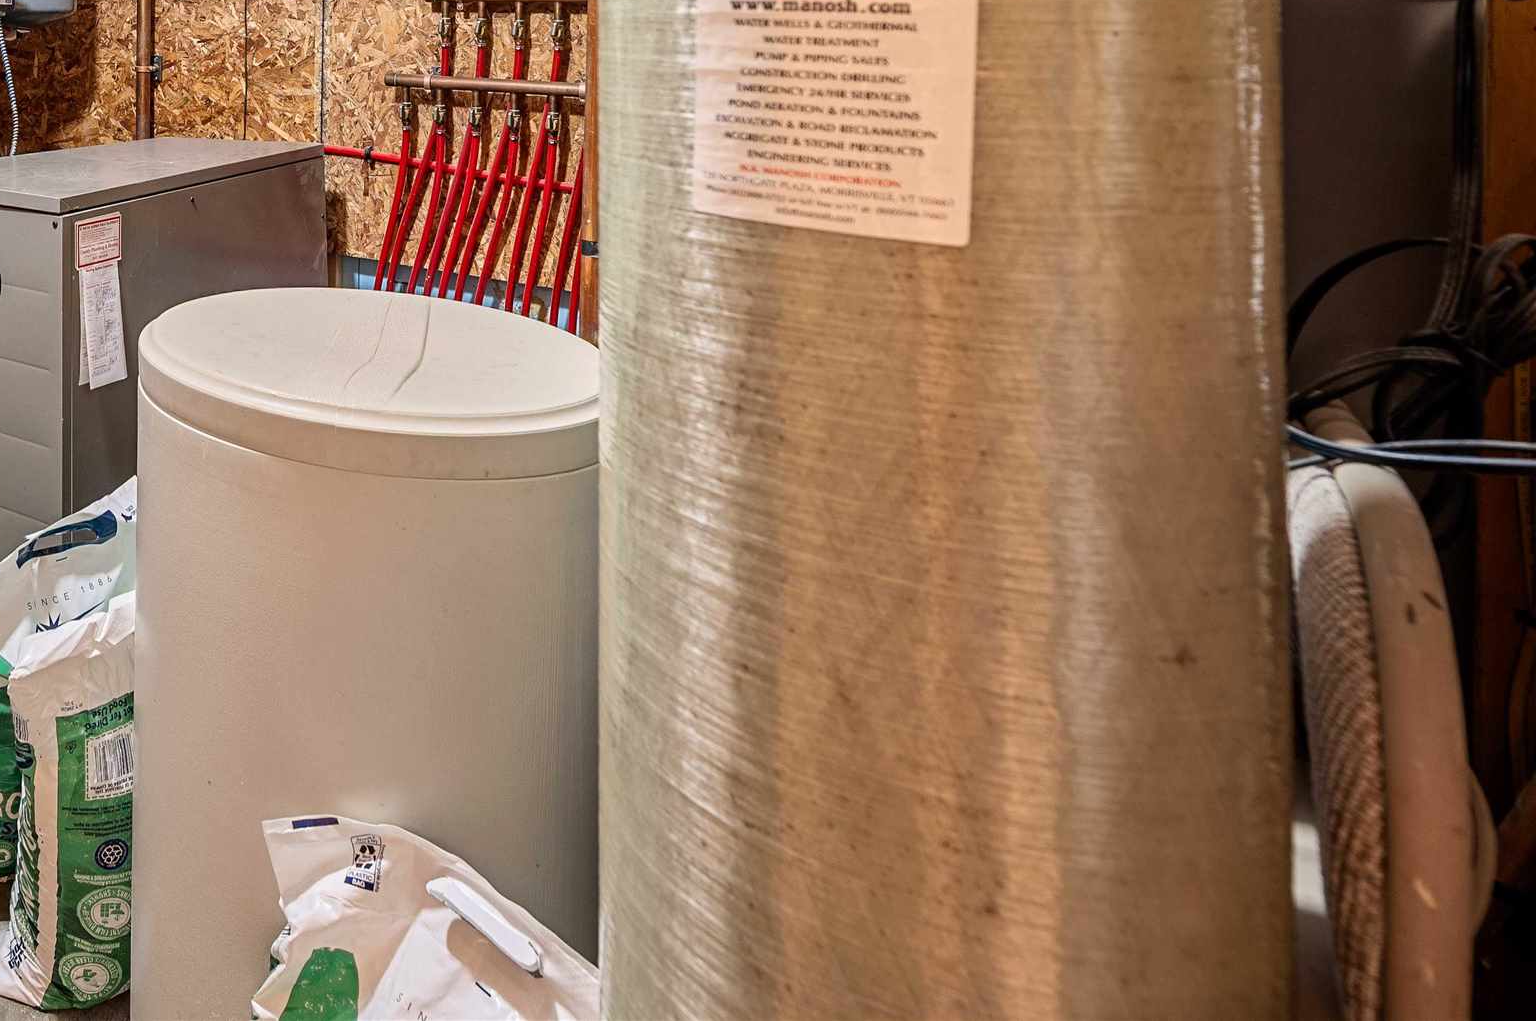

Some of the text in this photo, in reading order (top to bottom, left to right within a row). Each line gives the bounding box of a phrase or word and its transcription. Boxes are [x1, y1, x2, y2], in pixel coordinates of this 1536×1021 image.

[730, 0, 911, 15] www.manosh.com
[735, 18, 770, 28] WATER
[773, 19, 810, 28] WELLS
[763, 36, 880, 48] WATER TREATMENT
[754, 51, 788, 61] PUMP
[803, 54, 848, 64] PIPING
[852, 56, 889, 66] SALES
[740, 67, 906, 84] CONSTRUCTION DRILLING
[736, 83, 805, 96] EMERGENCY
[851, 91, 911, 102] SERVICES
[728, 99, 761, 109] POND
[841, 107, 921, 120] FOUNTAINS
[799, 122, 837, 132] ROAD
[804, 139, 845, 151] STONE
[850, 142, 924, 157] PRODUCTS
[833, 159, 892, 172] SERVICES
[26, 592, 71, 610] SINCE
